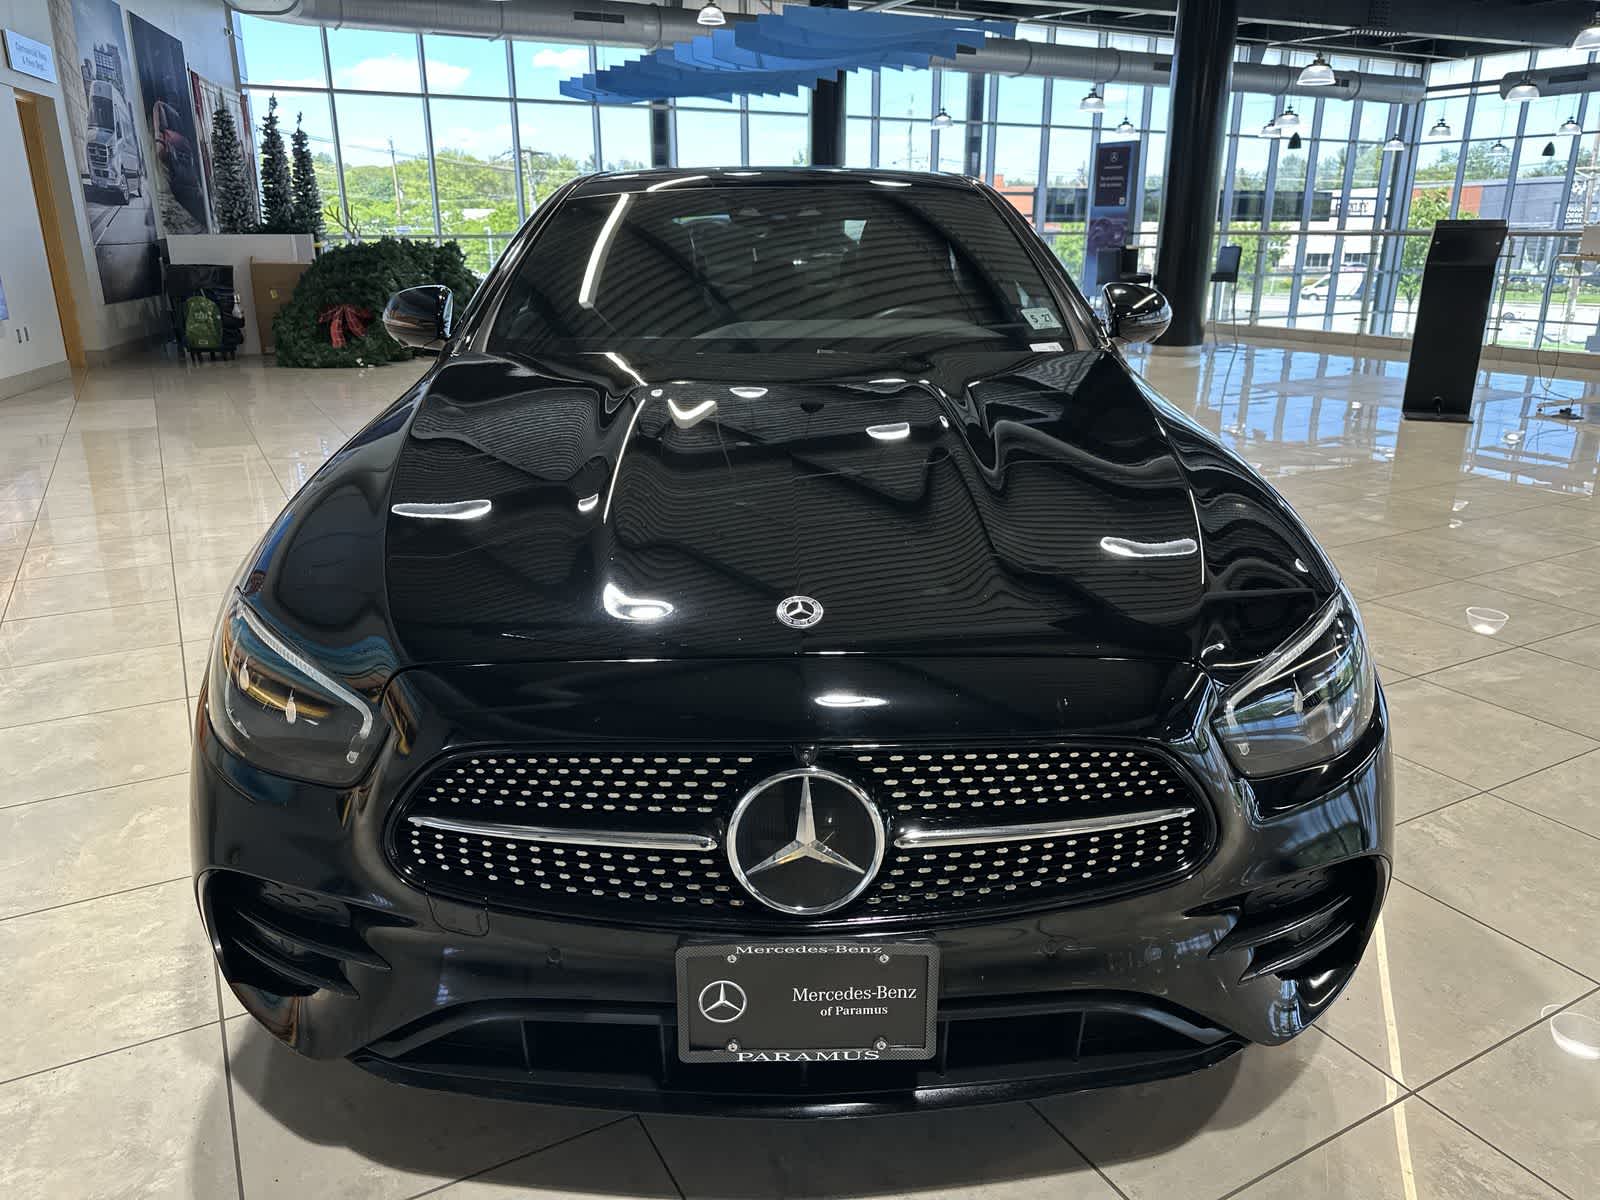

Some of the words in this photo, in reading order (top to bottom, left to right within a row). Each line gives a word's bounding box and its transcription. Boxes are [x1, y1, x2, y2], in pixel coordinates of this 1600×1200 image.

[735, 945, 882, 954] Mercedes-Benz
[792, 985, 917, 1002] Mercedes-Benz
[820, 1006, 831, 1017] of
[835, 1005, 888, 1016] Paramus
[736, 1049, 880, 1061] PARAMUS
